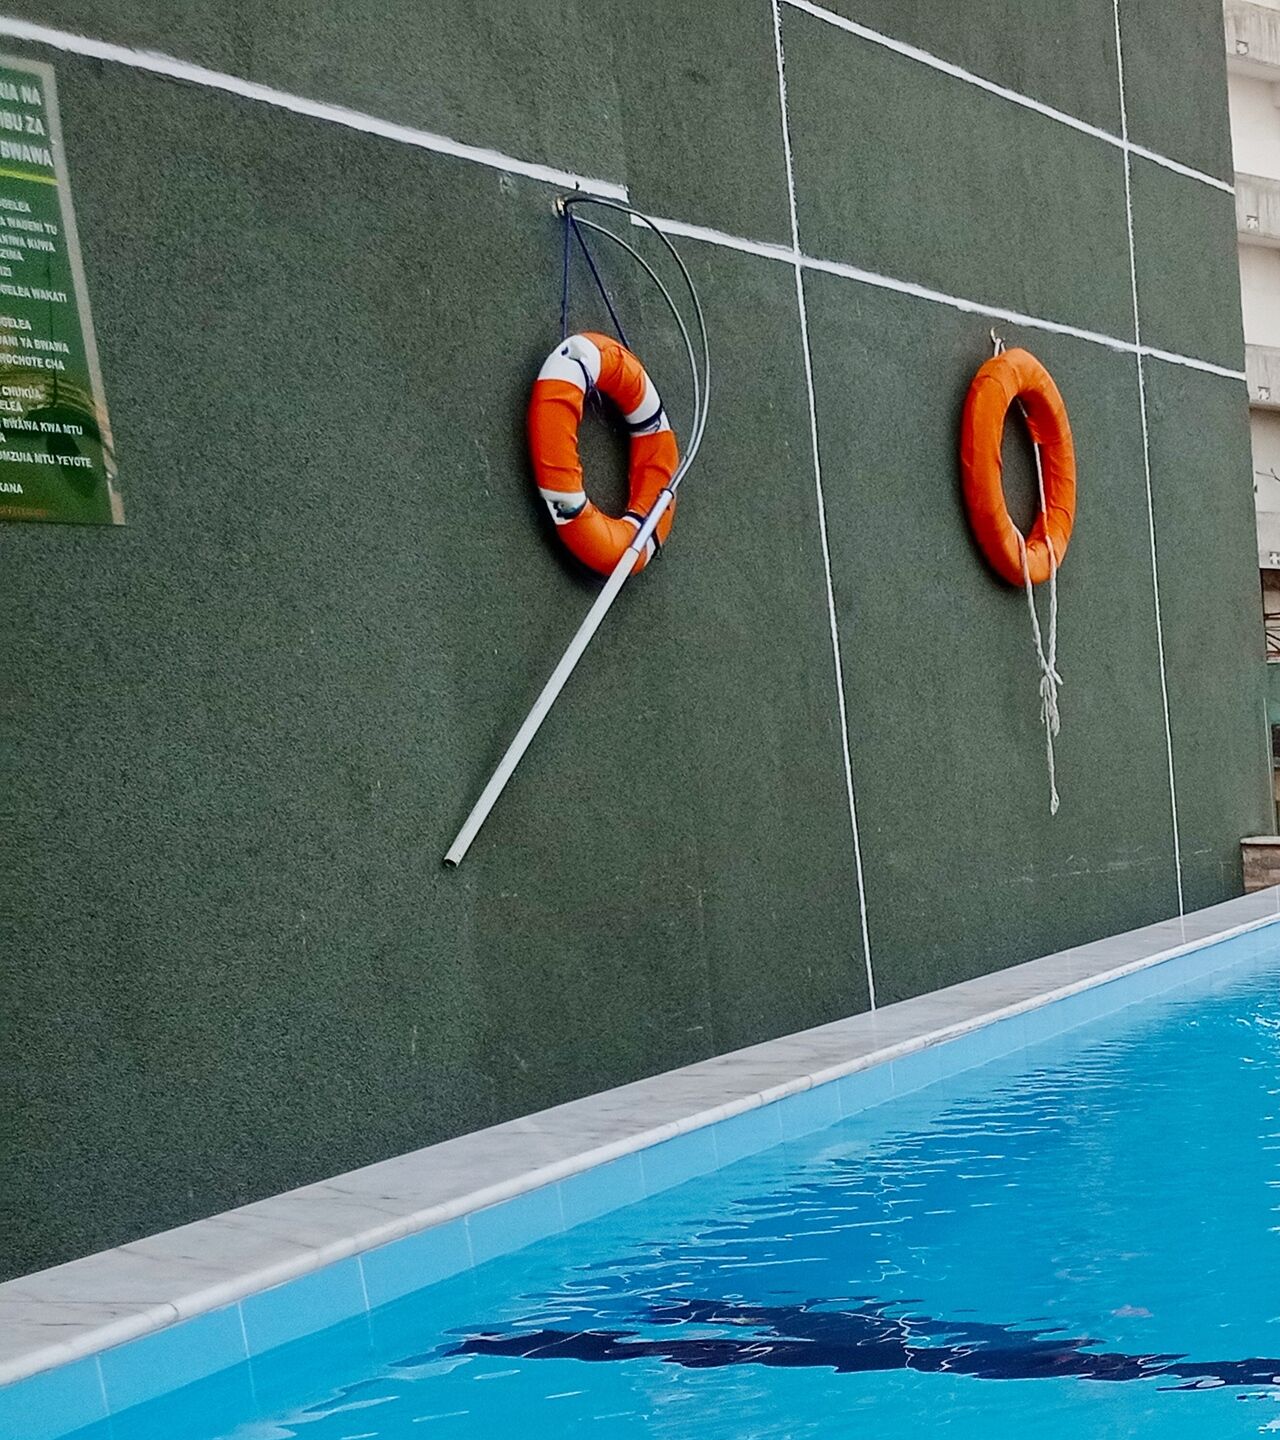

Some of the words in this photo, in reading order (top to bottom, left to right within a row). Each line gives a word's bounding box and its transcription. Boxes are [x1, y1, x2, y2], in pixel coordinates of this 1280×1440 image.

[20, 85, 42, 106] NA
[25, 115, 46, 137] ZA
[43, 221, 58, 236] TU
[26, 238, 56, 253] KUWA
[30, 285, 68, 304] WAKATI
[0, 316, 32, 331] GELEA
[20, 336, 34, 350] YA
[33, 338, 71, 355] BWAWA
[44, 357, 66, 371] CHA
[2, 417, 40, 432] BWAWA
[39, 421, 62, 434] KWA
[62, 423, 83, 436] MTU
[33, 451, 55, 465] MTU
[55, 454, 93, 468] YEYOTE
